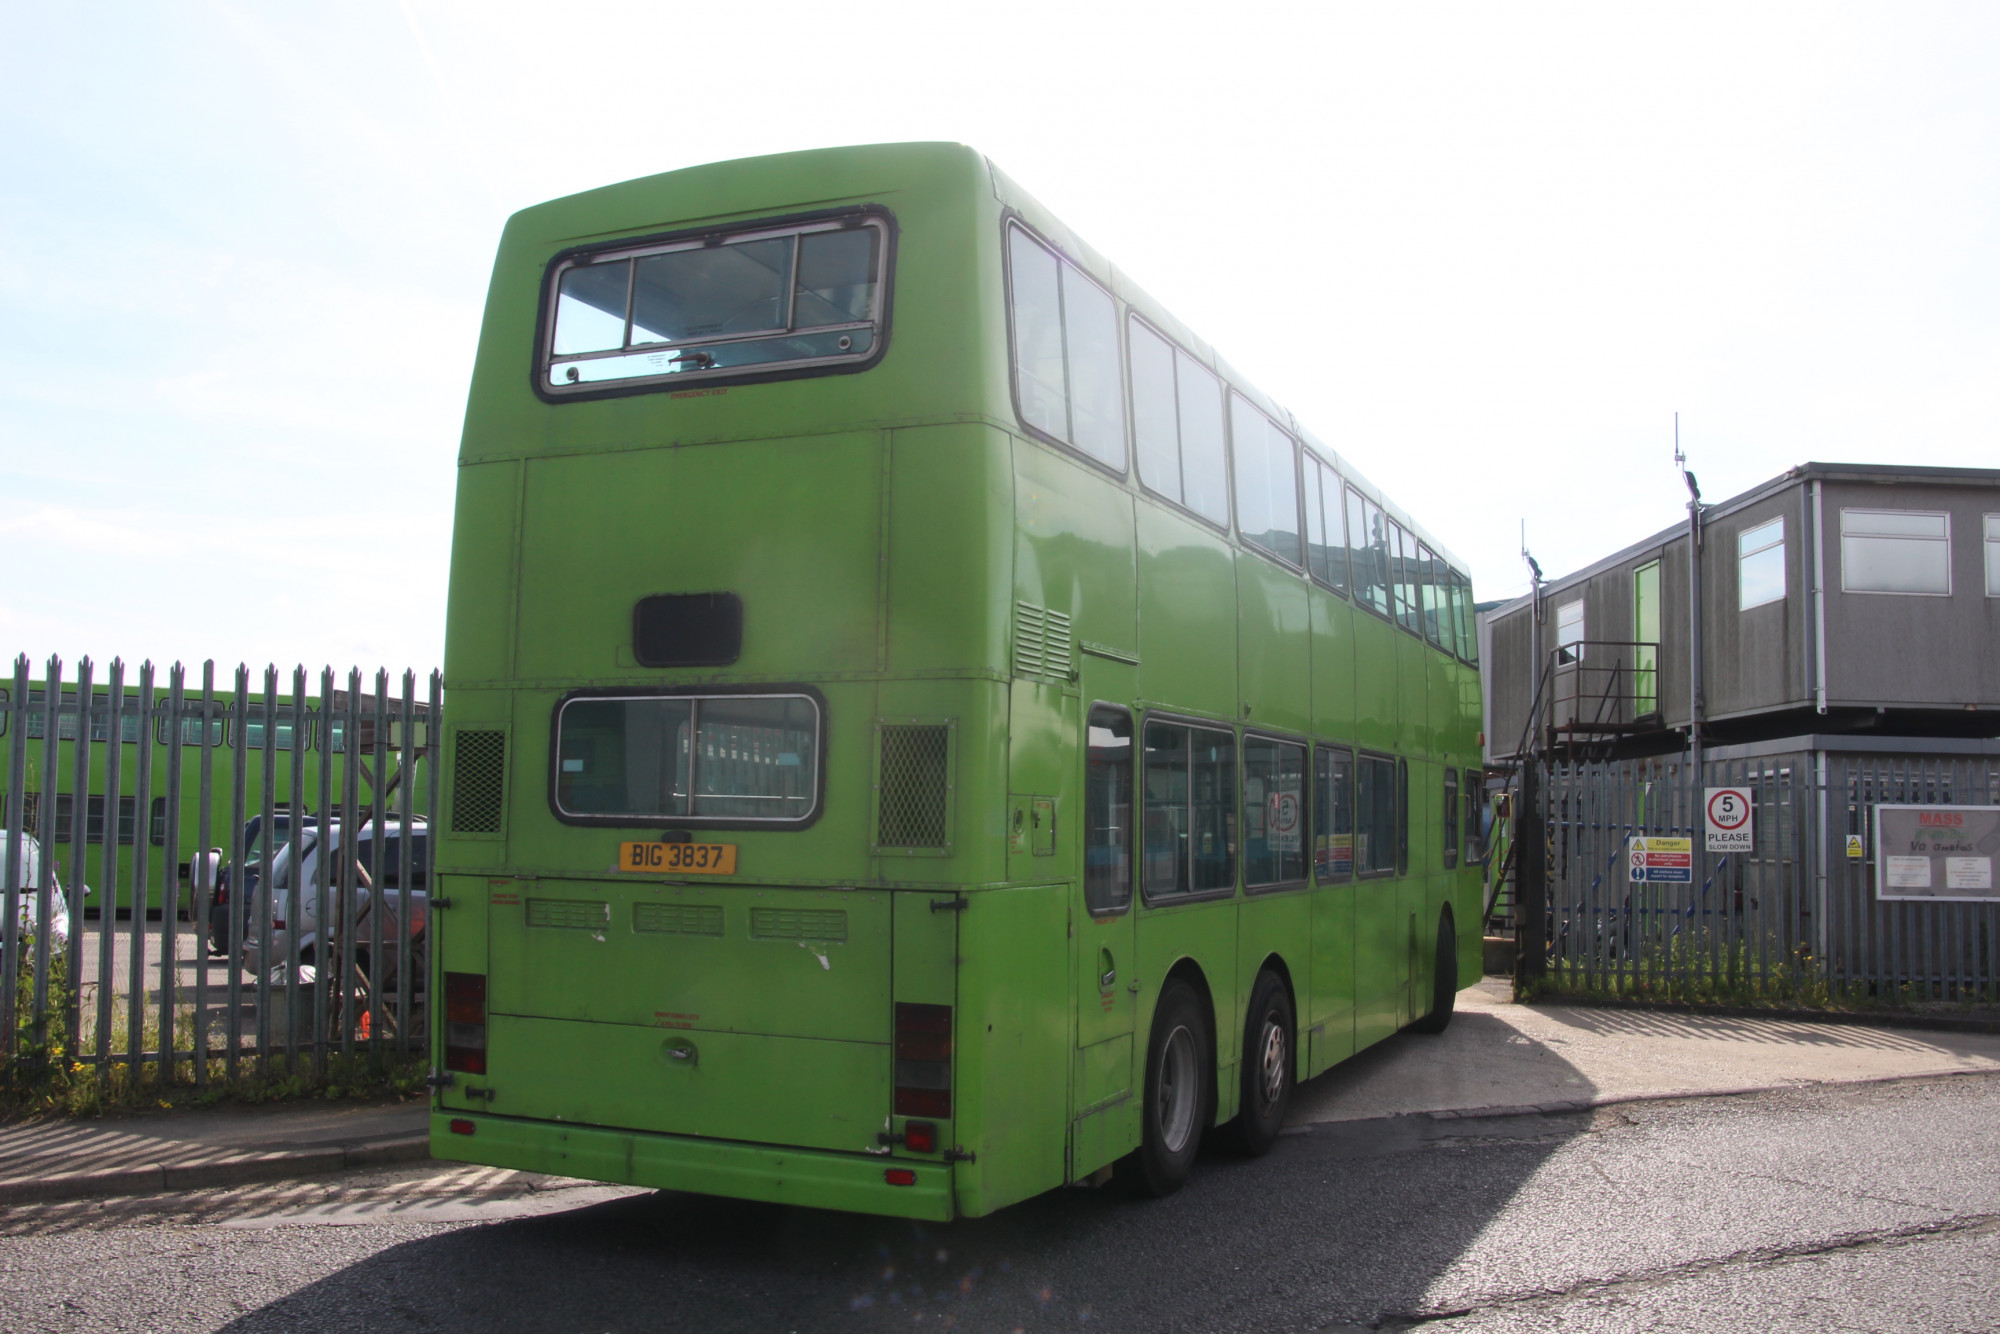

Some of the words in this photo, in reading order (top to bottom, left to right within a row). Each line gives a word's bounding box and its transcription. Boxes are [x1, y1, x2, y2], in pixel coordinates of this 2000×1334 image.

[1722, 796, 1734, 813] 5
[1920, 812, 1963, 825] MASS
[1708, 833, 1750, 842] PLEASE
[632, 844, 662, 866] BIG
[669, 845, 724, 868] 3837
